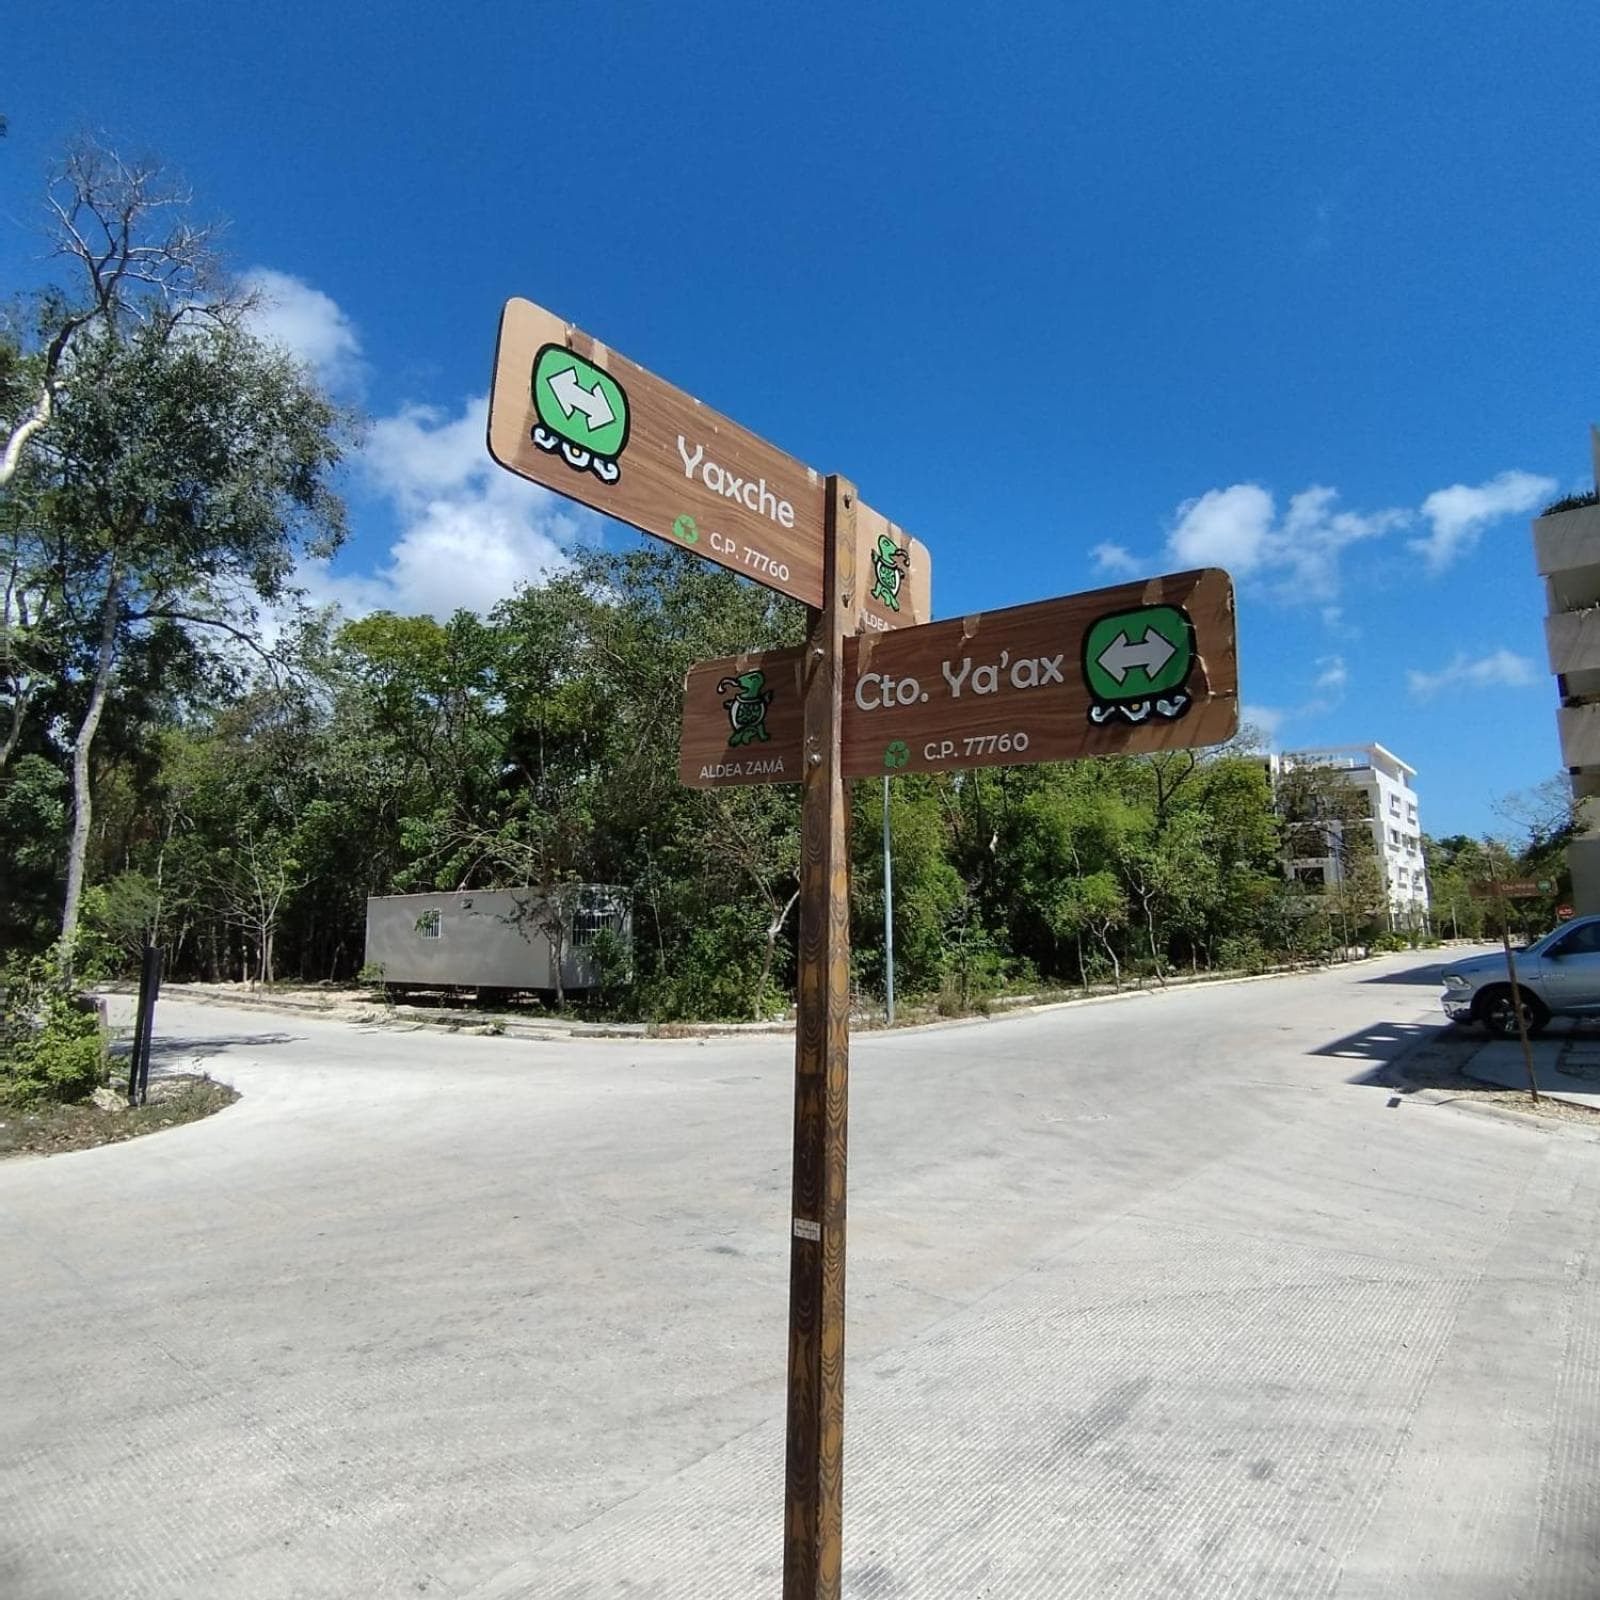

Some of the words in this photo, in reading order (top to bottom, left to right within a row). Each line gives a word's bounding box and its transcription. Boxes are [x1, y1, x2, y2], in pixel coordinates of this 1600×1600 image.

[677, 434, 795, 528] Yaxche
[709, 532, 739, 560] C.P.
[743, 546, 790, 581] 77760
[862, 609, 889, 631] LDEA
[855, 672, 929, 711] Cto.
[923, 742, 958, 760] C.P.
[963, 732, 1029, 756] 77760
[699, 762, 742, 779] ALDEA
[745, 755, 785, 775] ZAMÁ
